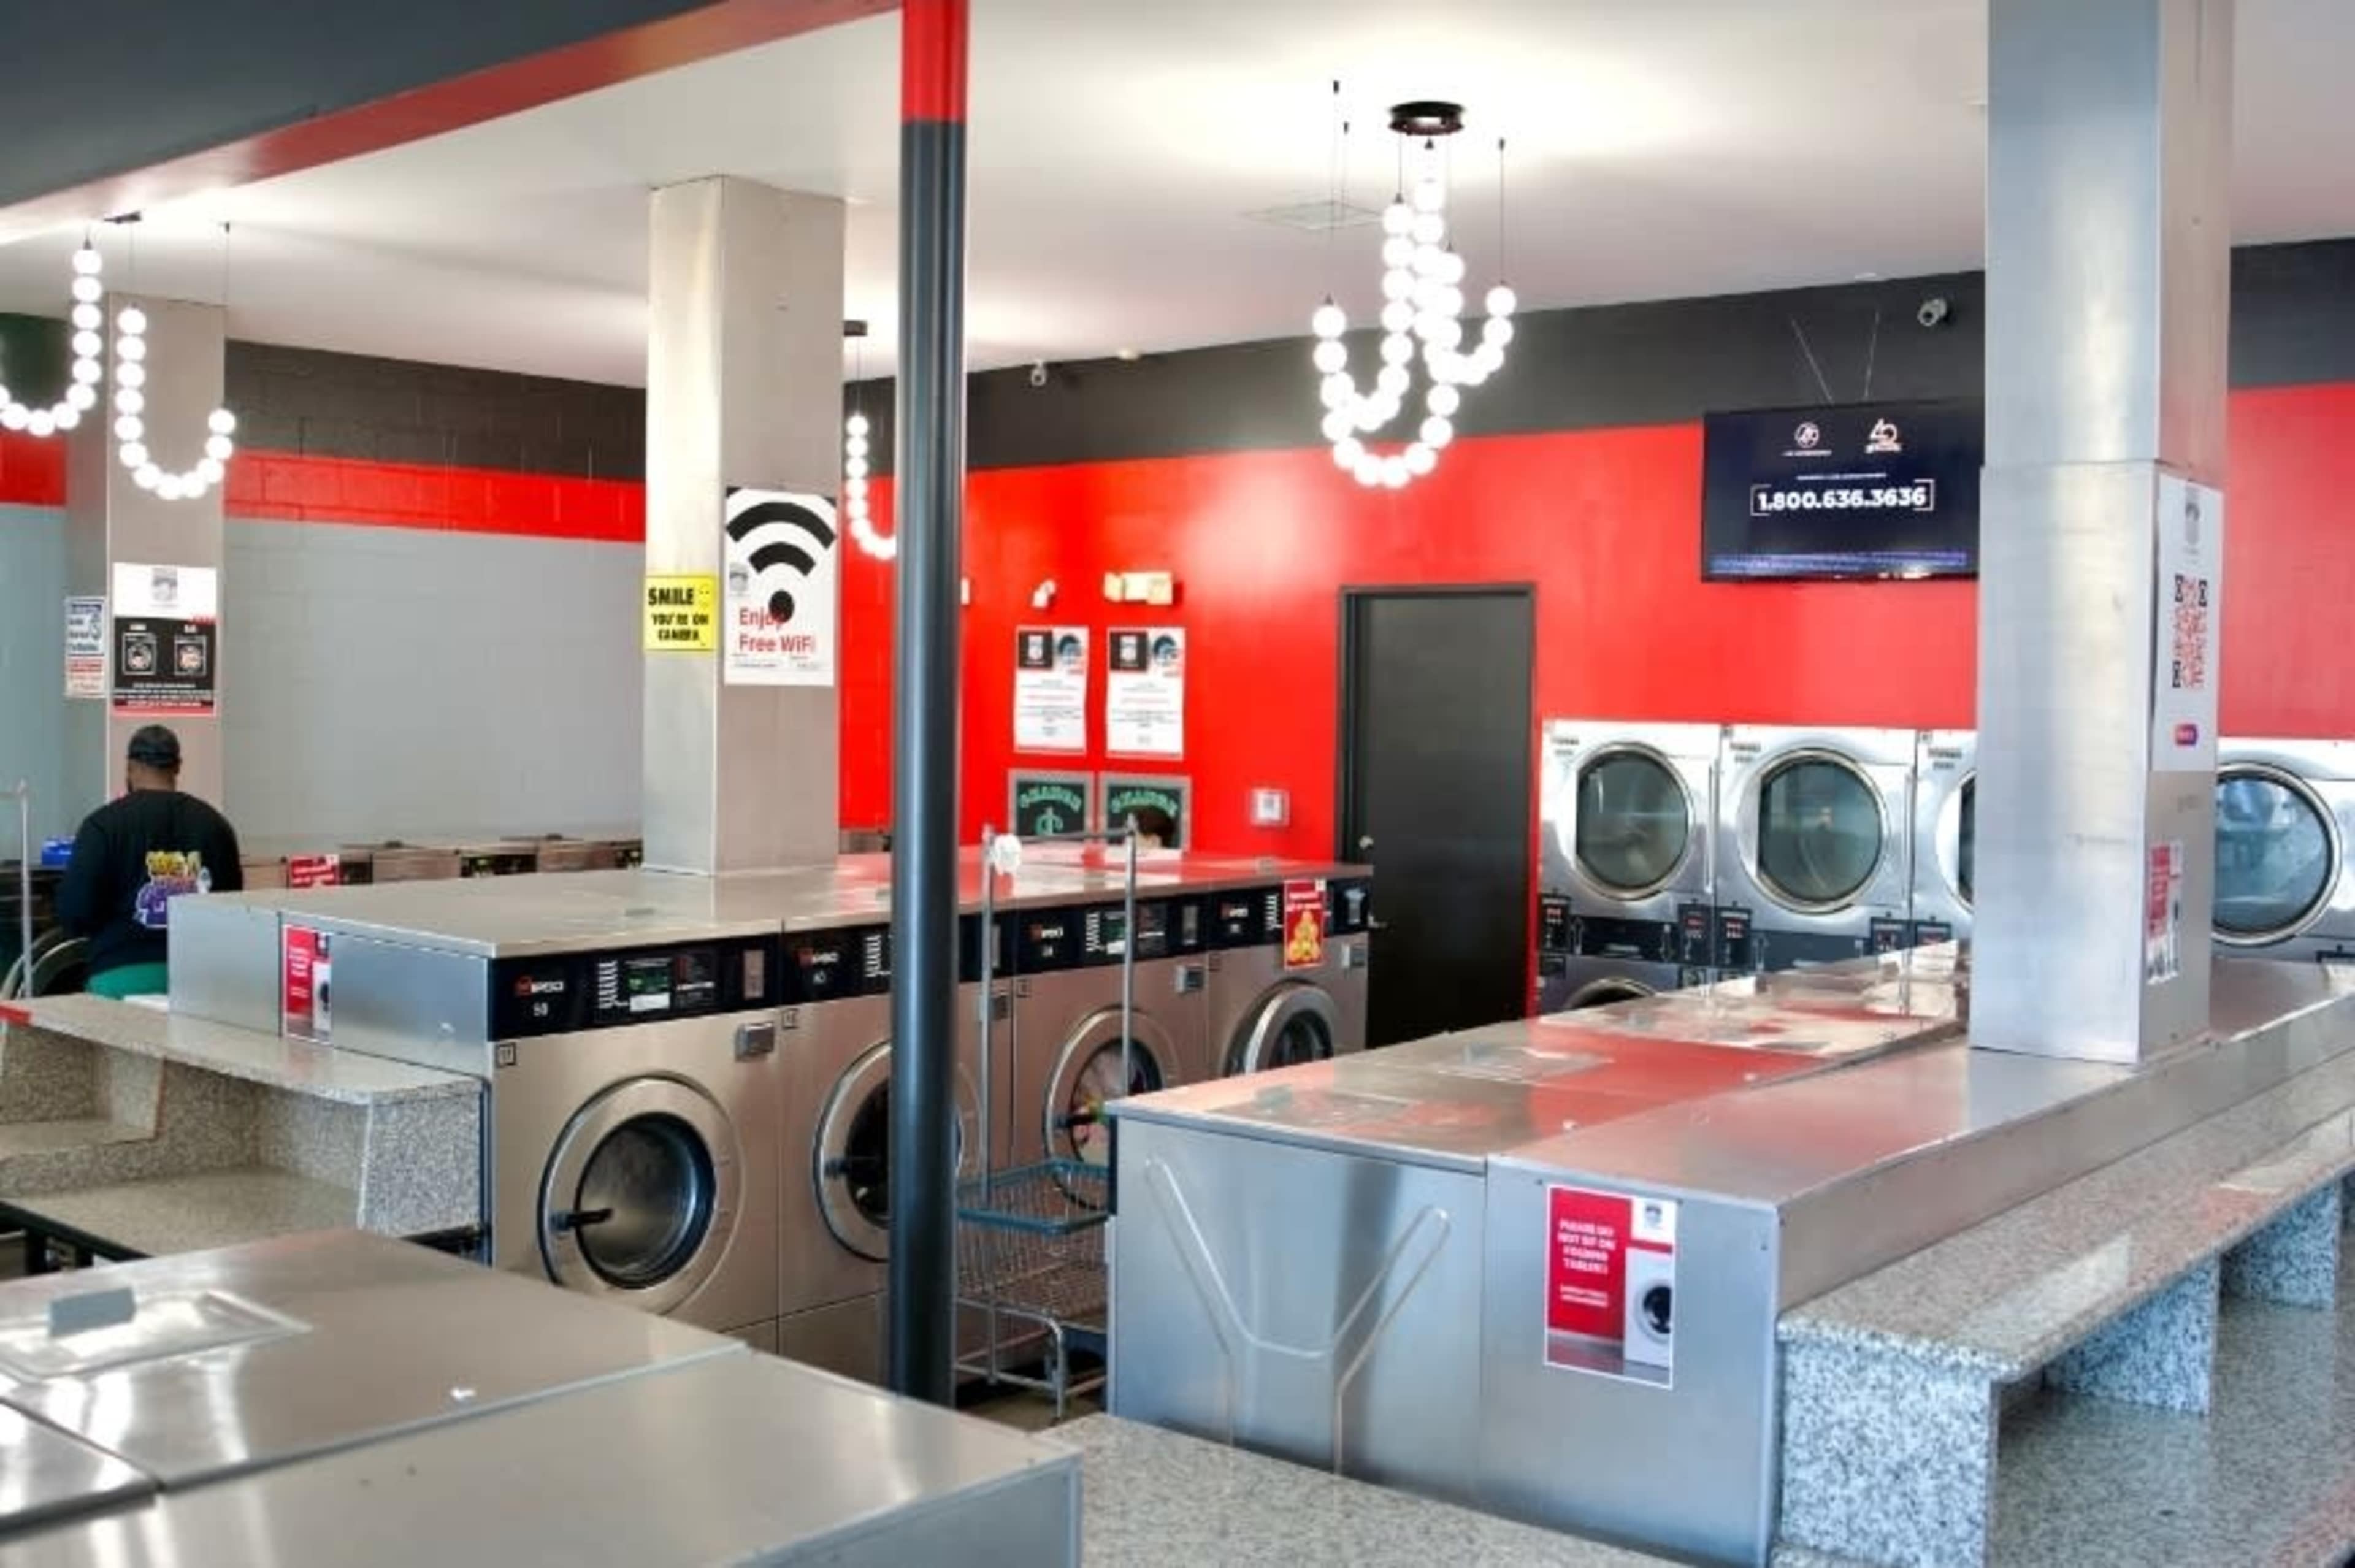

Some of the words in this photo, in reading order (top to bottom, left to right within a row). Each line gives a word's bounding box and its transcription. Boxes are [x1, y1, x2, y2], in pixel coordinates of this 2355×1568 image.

[648, 587, 694, 606] SMILE
[692, 613, 708, 625] ON
[740, 607, 784, 631] Enjoy
[658, 629, 699, 641] CAMERA
[740, 634, 776, 652] Free
[780, 635, 816, 652] WiFi
